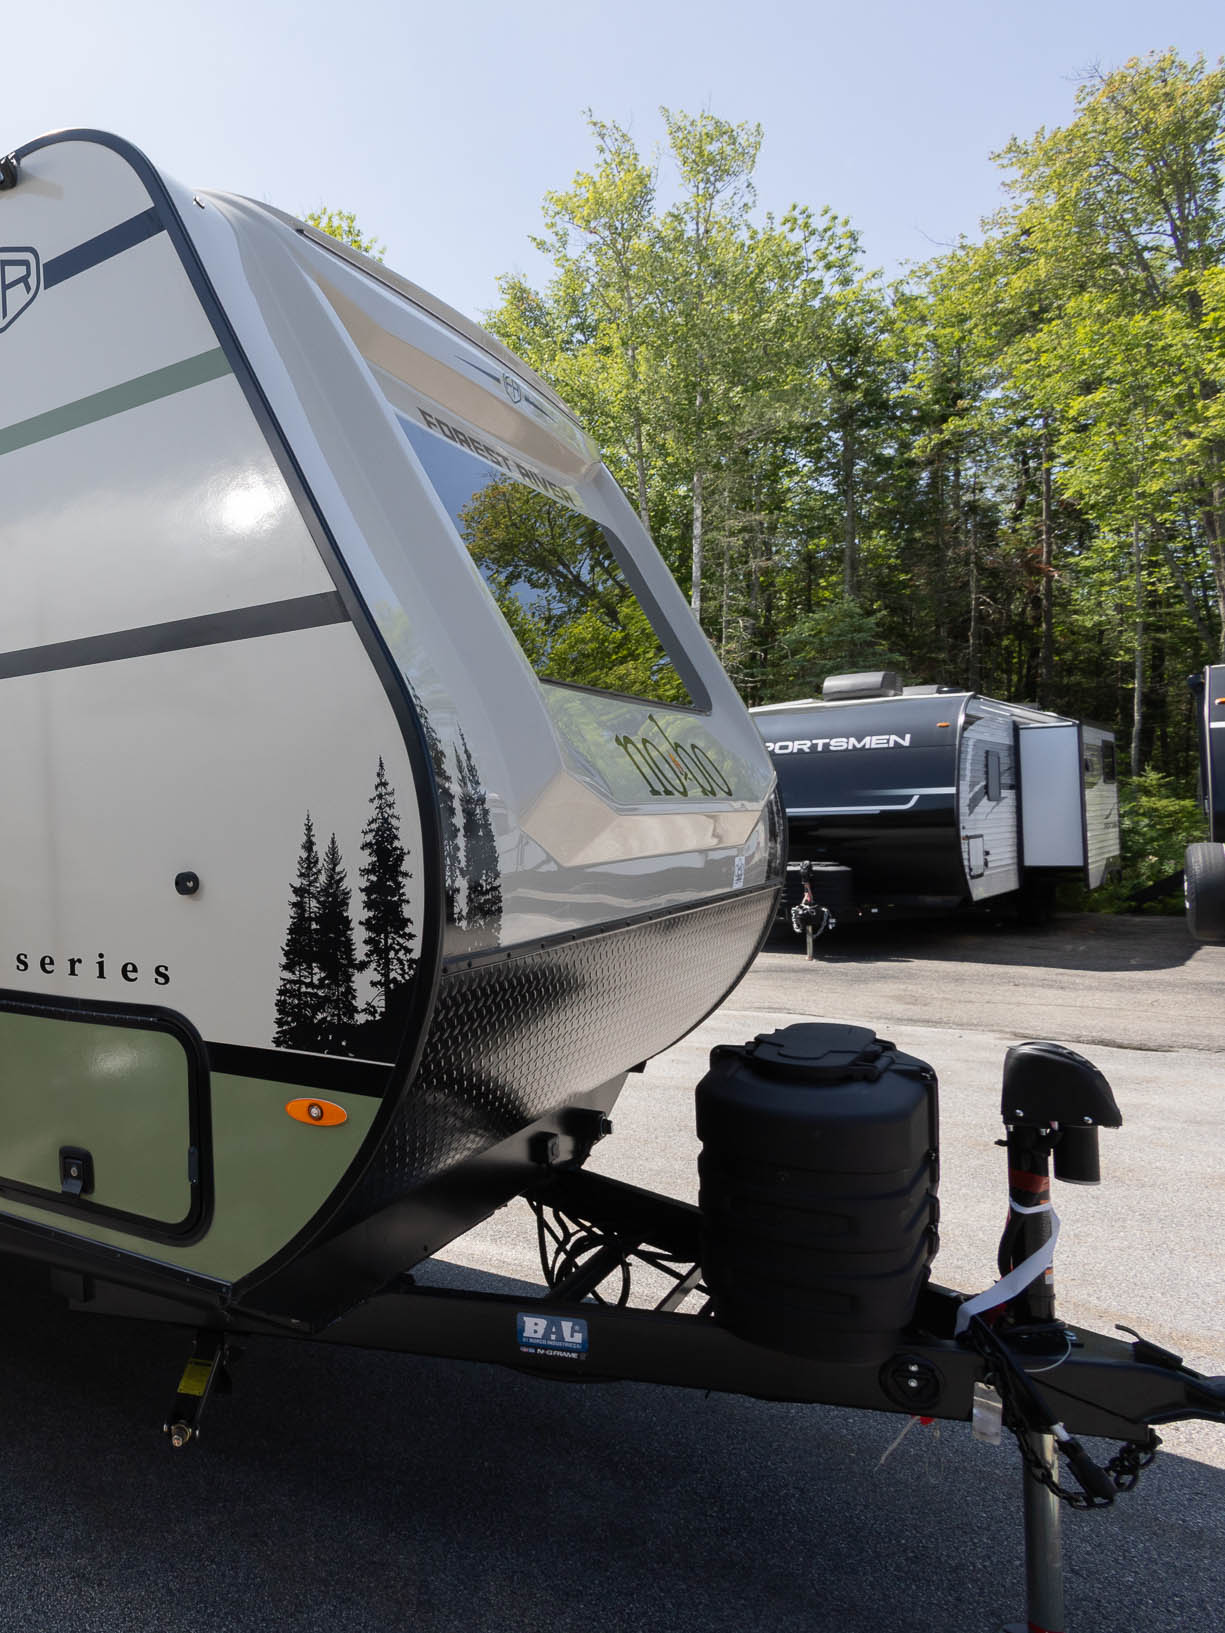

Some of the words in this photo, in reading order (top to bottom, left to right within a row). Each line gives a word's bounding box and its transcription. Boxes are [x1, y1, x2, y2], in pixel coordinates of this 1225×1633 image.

[416, 406, 512, 473] FOREST
[513, 460, 578, 507] RIVER
[765, 733, 912, 754] PORTSMEN
[15, 952, 171, 986] series
[523, 1316, 583, 1344] BAL
